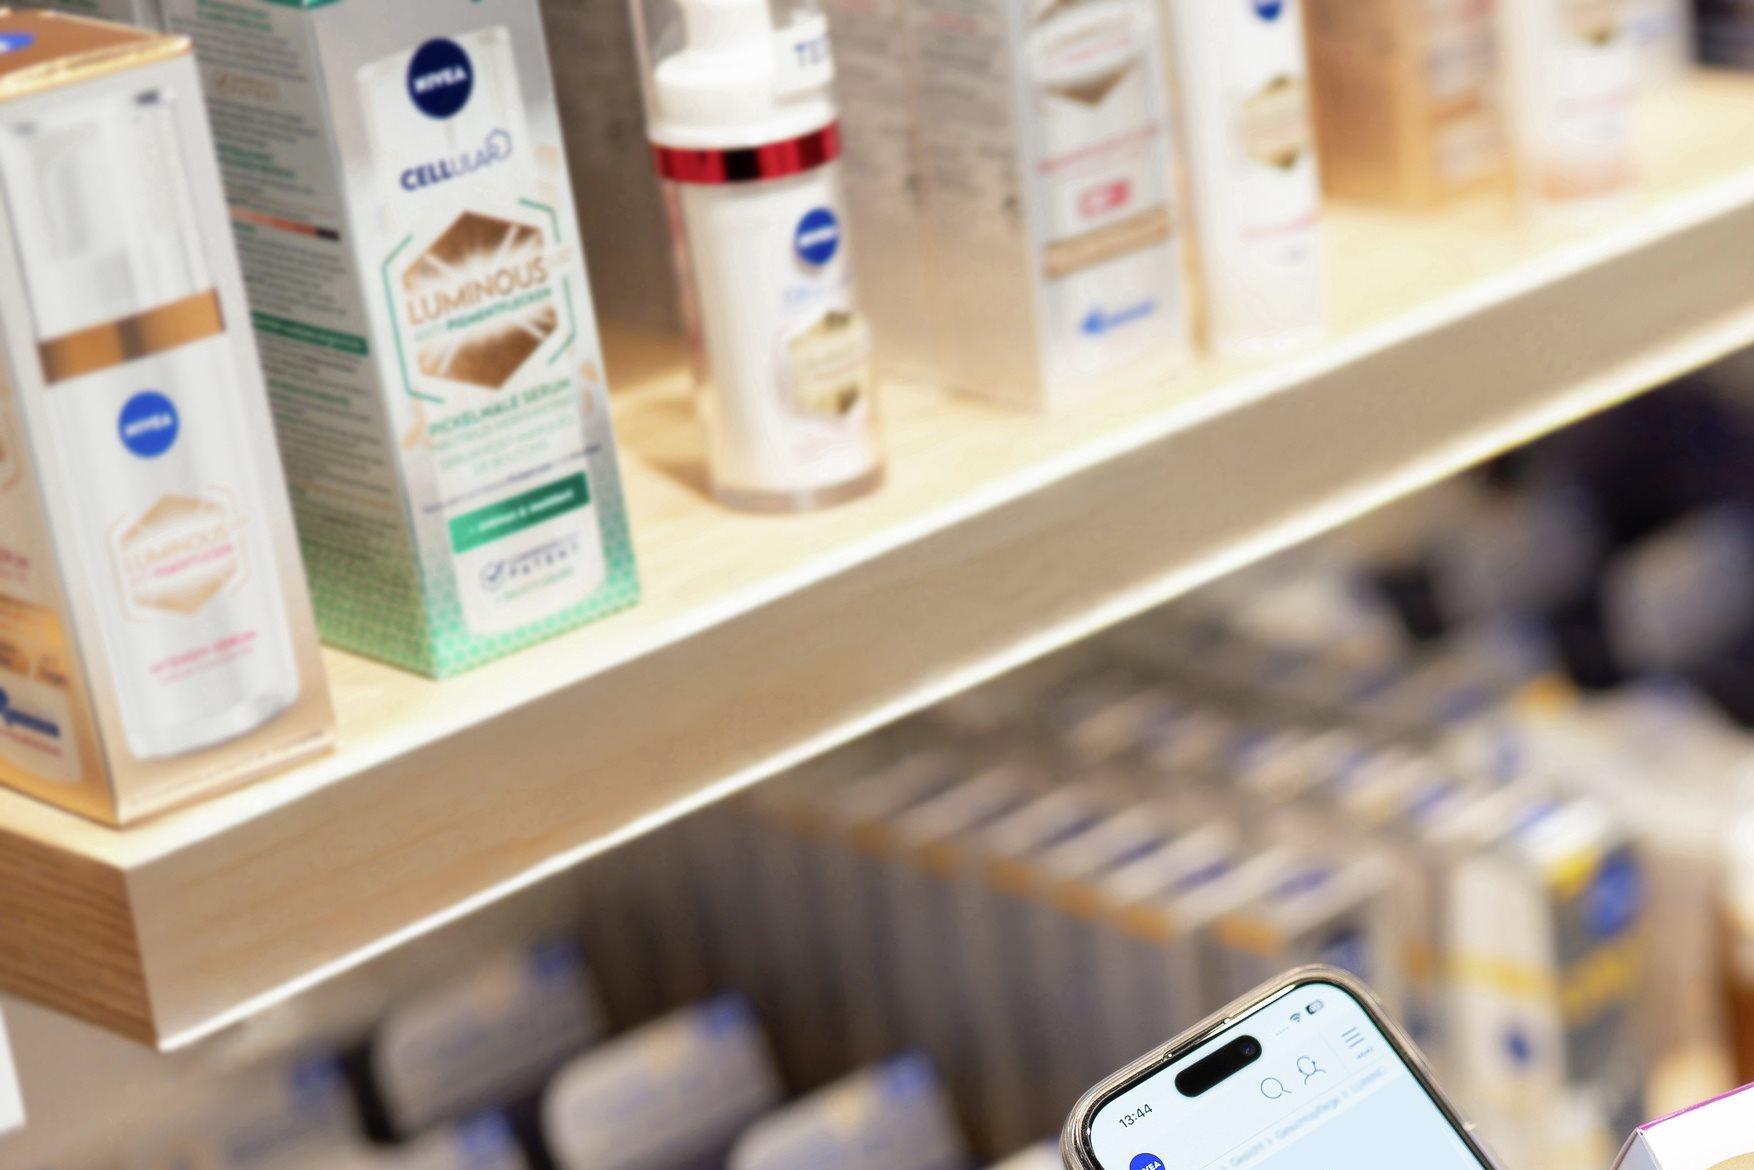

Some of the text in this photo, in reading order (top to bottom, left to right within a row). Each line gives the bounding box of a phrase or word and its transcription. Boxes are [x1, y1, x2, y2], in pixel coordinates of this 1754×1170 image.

[414, 65, 467, 93] NIVEA
[407, 256, 548, 326] LUMINOUS
[1119, 1103, 1152, 1128] 13:44
